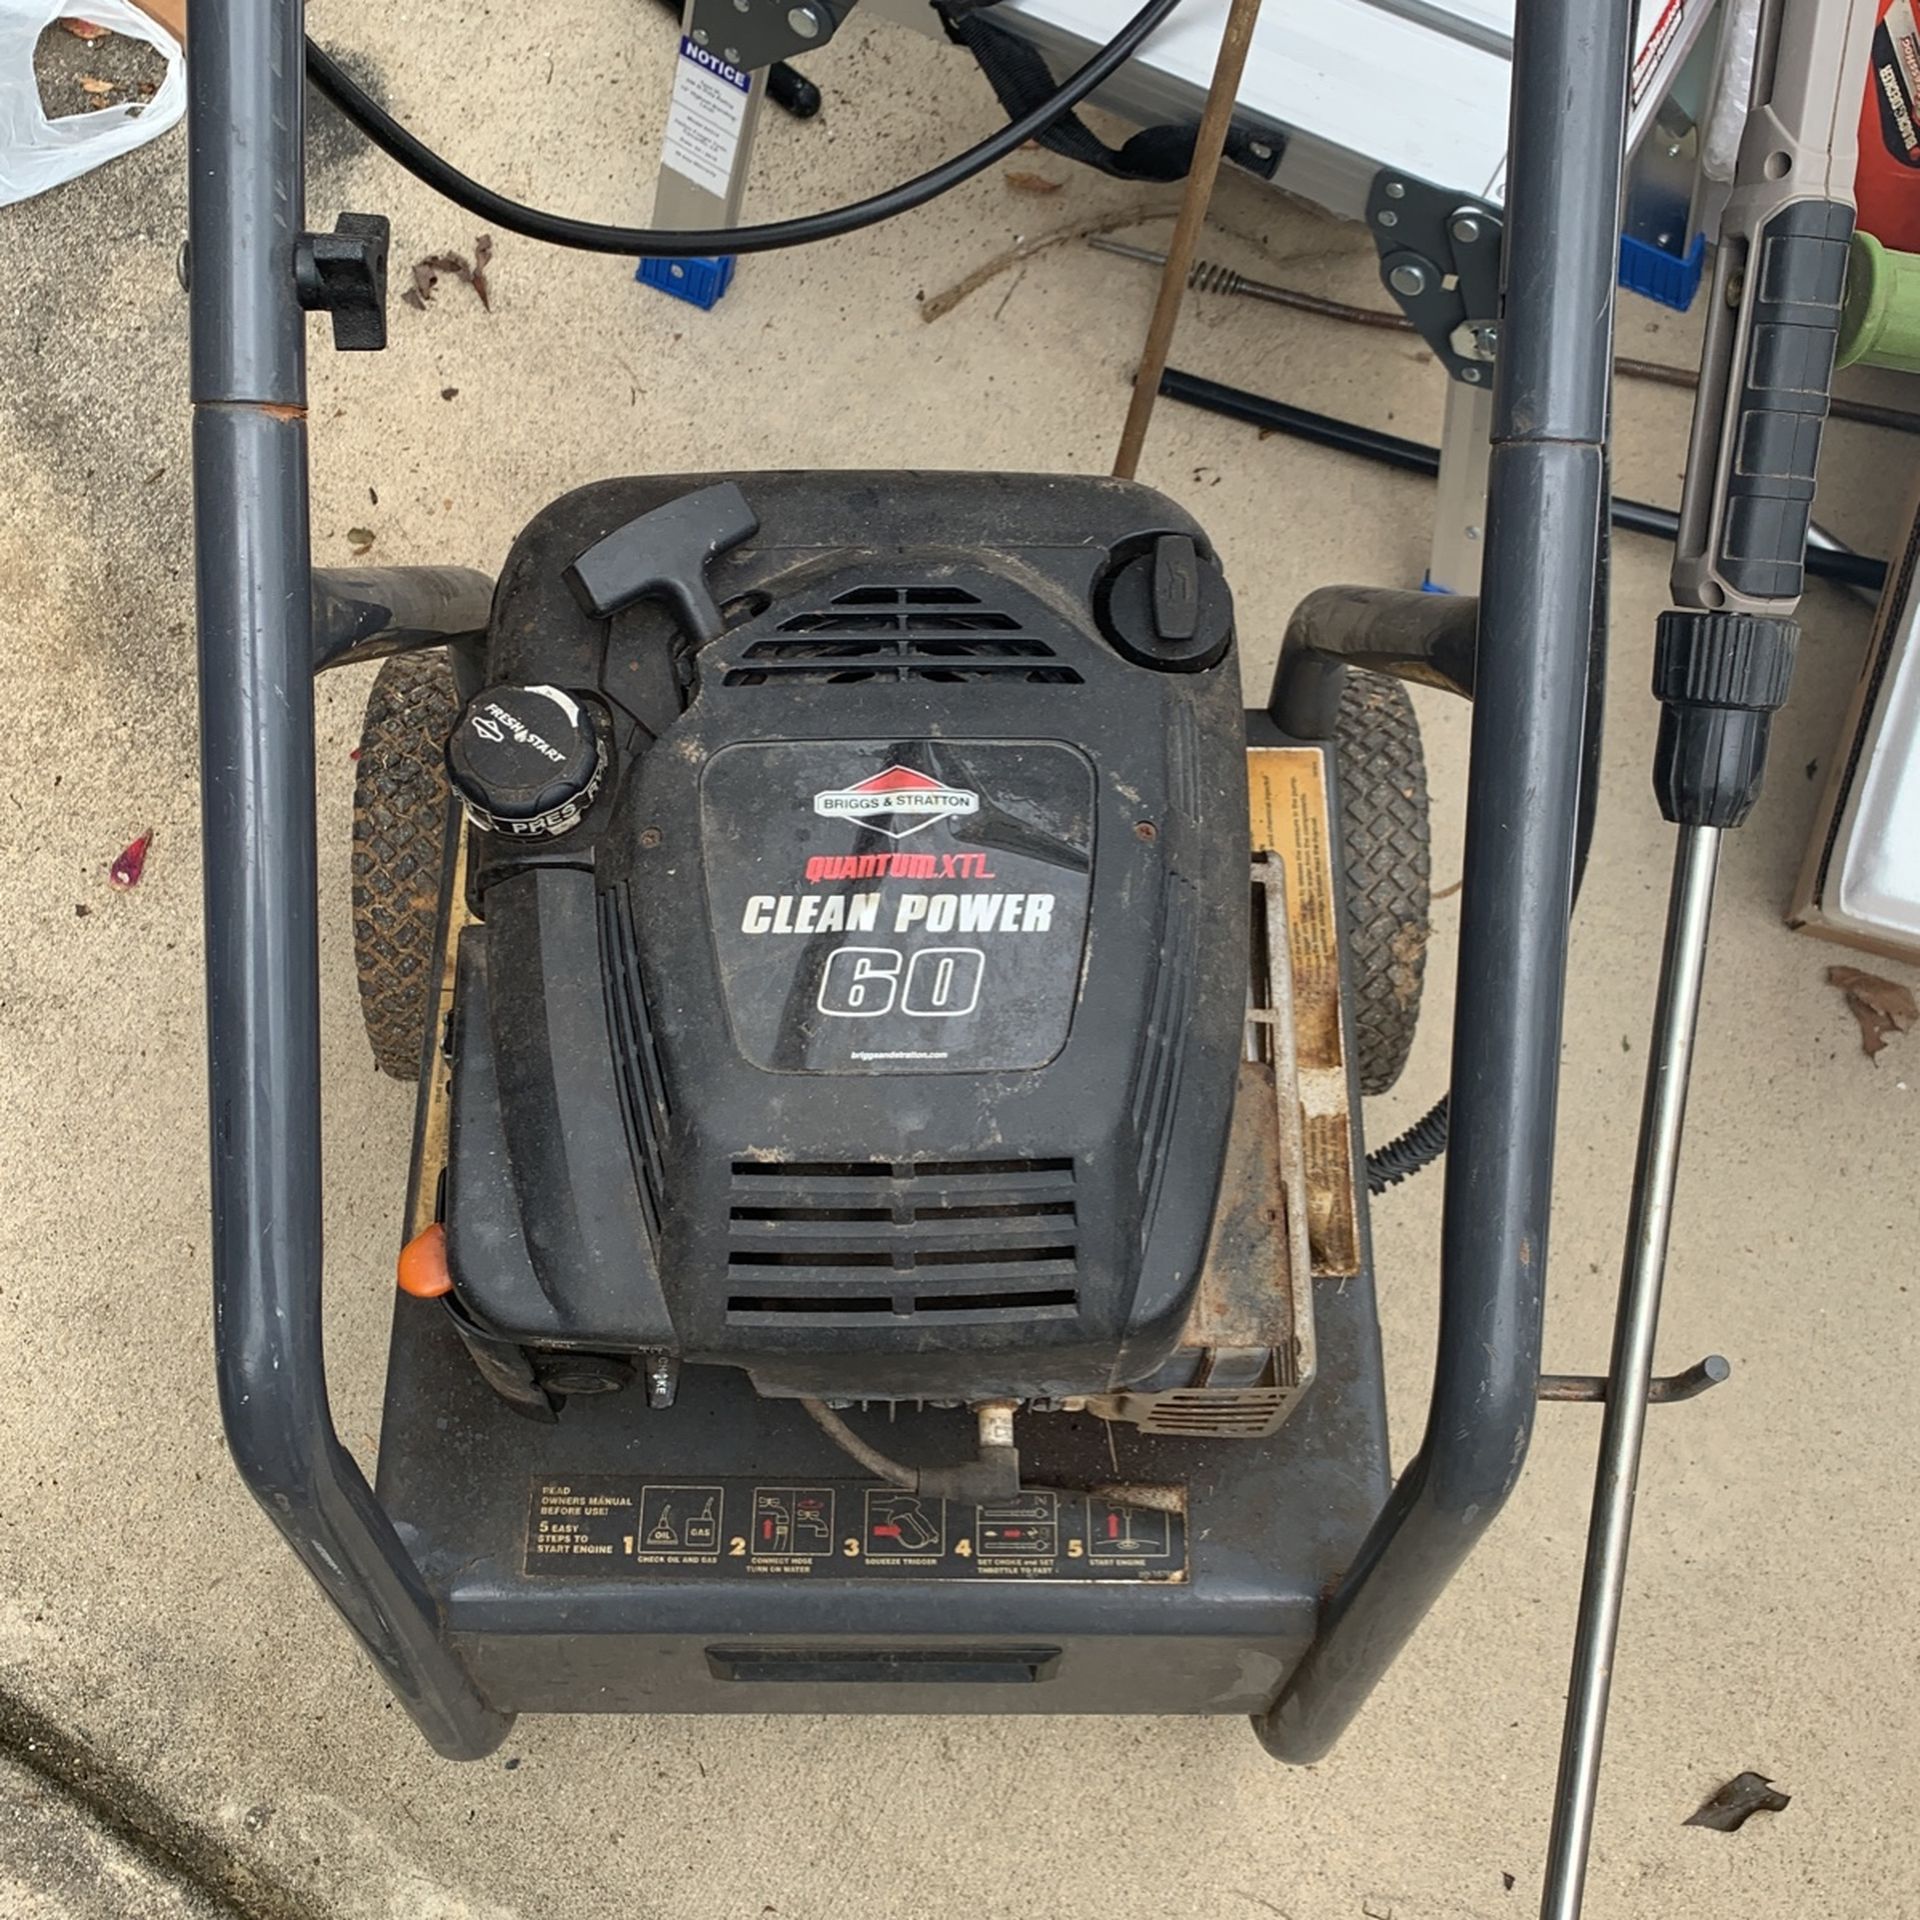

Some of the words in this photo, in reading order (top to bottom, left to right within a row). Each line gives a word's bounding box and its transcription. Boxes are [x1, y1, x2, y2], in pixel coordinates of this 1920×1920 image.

[686, 41, 746, 87] NOTICE
[484, 703, 522, 732] FRESH
[526, 733, 566, 762] START
[823, 797, 880, 810] BRIGGS
[883, 795, 893, 808] &
[896, 793, 970, 808] STRATTON
[741, 893, 882, 934] CLEAN
[894, 893, 1056, 933] POWER
[817, 946, 985, 1017] 60
[542, 1486, 571, 1495] READ
[541, 1497, 586, 1506] OWNERS
[588, 1497, 633, 1506] MANUAL
[540, 1506, 582, 1516] BEFORE
[584, 1507, 609, 1516] USE!
[539, 1520, 549, 1533] 5
[551, 1524, 580, 1533] EASY
[654, 1531, 671, 1540] OIL
[690, 1528, 711, 1537] GAS
[538, 1534, 572, 1543] STEPS
[574, 1534, 589, 1543] TO
[537, 1545, 572, 1554] START
[573, 1545, 614, 1555] ENGINE
[623, 1536, 634, 1555] 1
[729, 1537, 746, 1556] 2
[843, 1538, 860, 1557] 3
[955, 1539, 973, 1557] 4
[1067, 1539, 1084, 1558] 5
[637, 1556, 665, 1564] CHECK
[667, 1556, 680, 1564] OIL
[682, 1556, 699, 1564] AND
[701, 1556, 718, 1564] GAS
[751, 1557, 789, 1565] CONNECT
[865, 1558, 900, 1566] SQUEEZE
[902, 1558, 938, 1566] TRIGGER
[977, 1558, 993, 1566] SET
[1039, 1558, 1054, 1566] SET
[1115, 1559, 1147, 1567] ENGINE
[746, 1565, 769, 1573] TURN
[783, 1566, 811, 1574] WATER
[978, 1566, 1019, 1574] THROTTLE
[1021, 1566, 1031, 1574] TO
[1032, 1566, 1053, 1574] FAST
